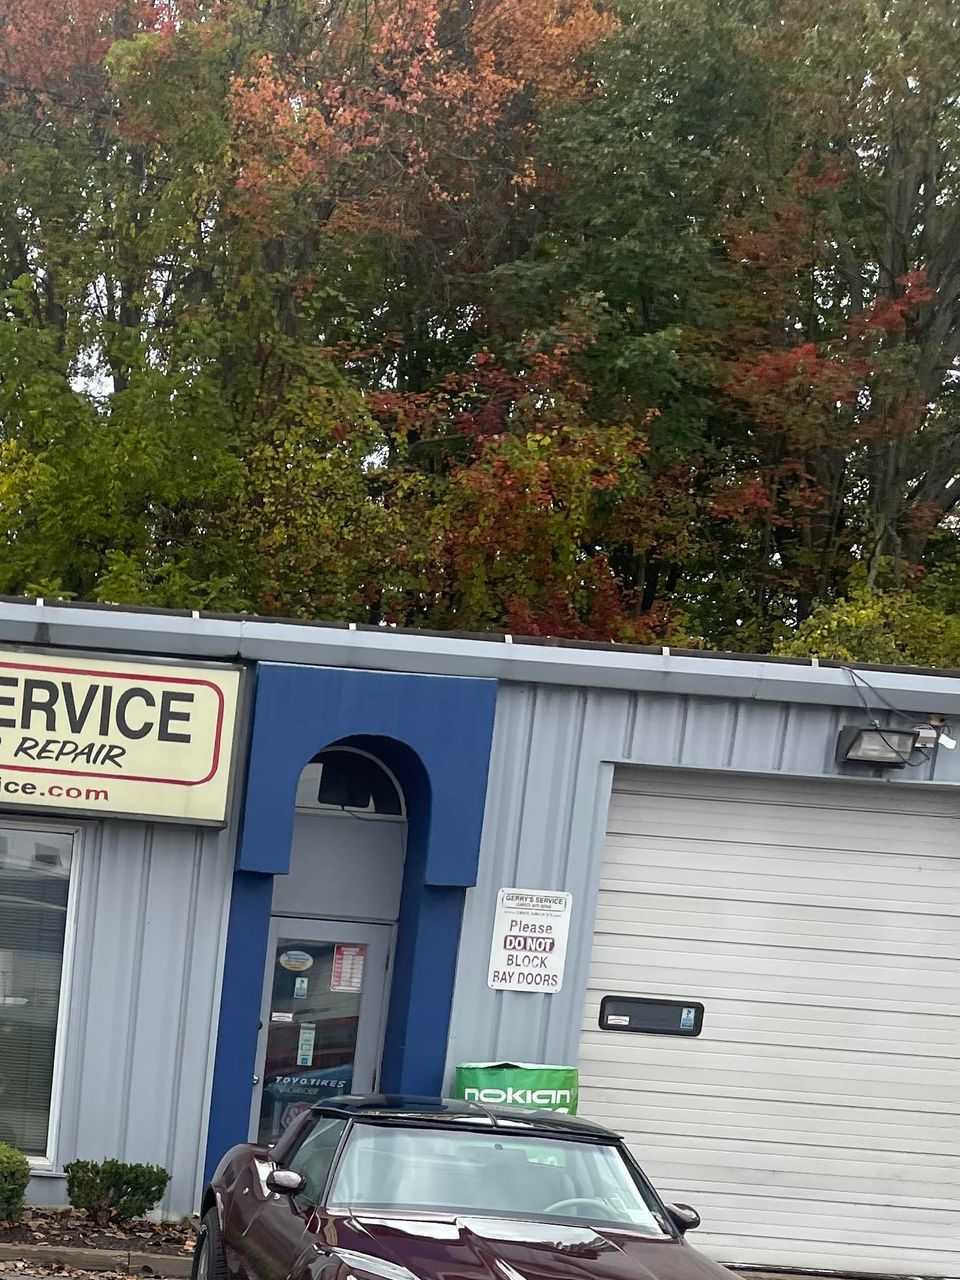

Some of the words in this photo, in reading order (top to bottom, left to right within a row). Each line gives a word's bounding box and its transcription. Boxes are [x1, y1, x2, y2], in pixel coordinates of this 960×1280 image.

[15, 736, 127, 769] REPAIR
[536, 896, 563, 905] SERVICE
[509, 919, 553, 934] Please
[506, 936, 524, 950] DO
[526, 938, 553, 952] NOT
[506, 954, 548, 969] BLOCK
[492, 970, 515, 983] BAY
[518, 972, 558, 986] DOORS
